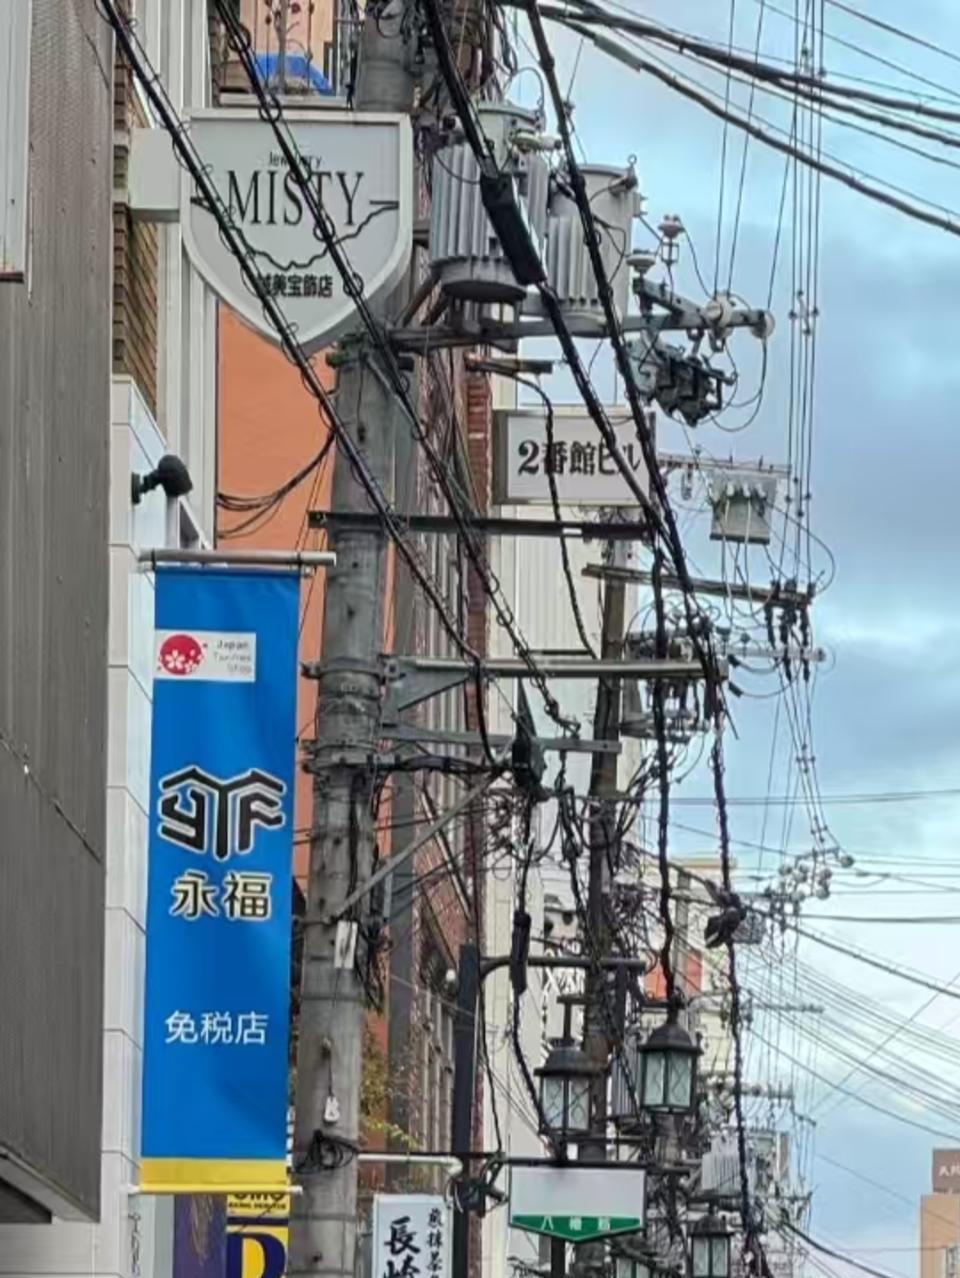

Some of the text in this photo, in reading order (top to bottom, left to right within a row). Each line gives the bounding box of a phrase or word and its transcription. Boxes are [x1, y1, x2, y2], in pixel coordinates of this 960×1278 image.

[227, 169, 364, 226] MISTY
[517, 438, 642, 476] 2番館ビル
[170, 868, 273, 920] 永福
[163, 1010, 270, 1046] 免税店
